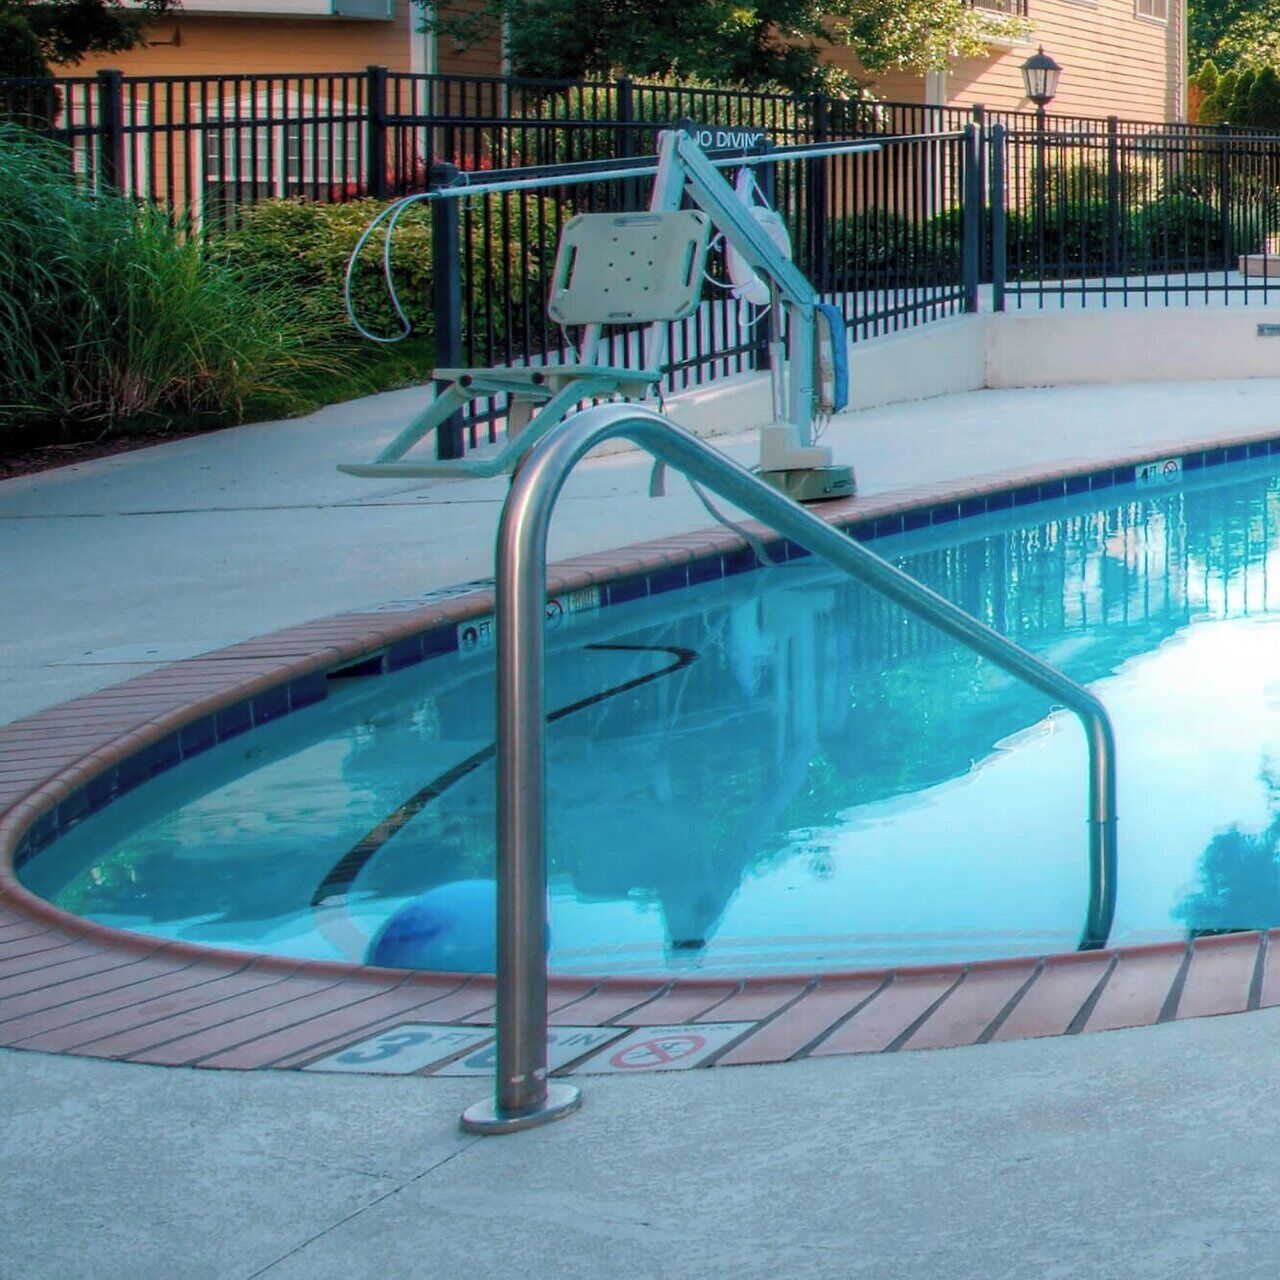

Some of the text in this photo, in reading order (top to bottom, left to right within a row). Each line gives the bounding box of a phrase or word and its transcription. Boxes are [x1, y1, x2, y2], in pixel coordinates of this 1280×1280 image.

[336, 1032, 609, 1065] 3 FT IN
